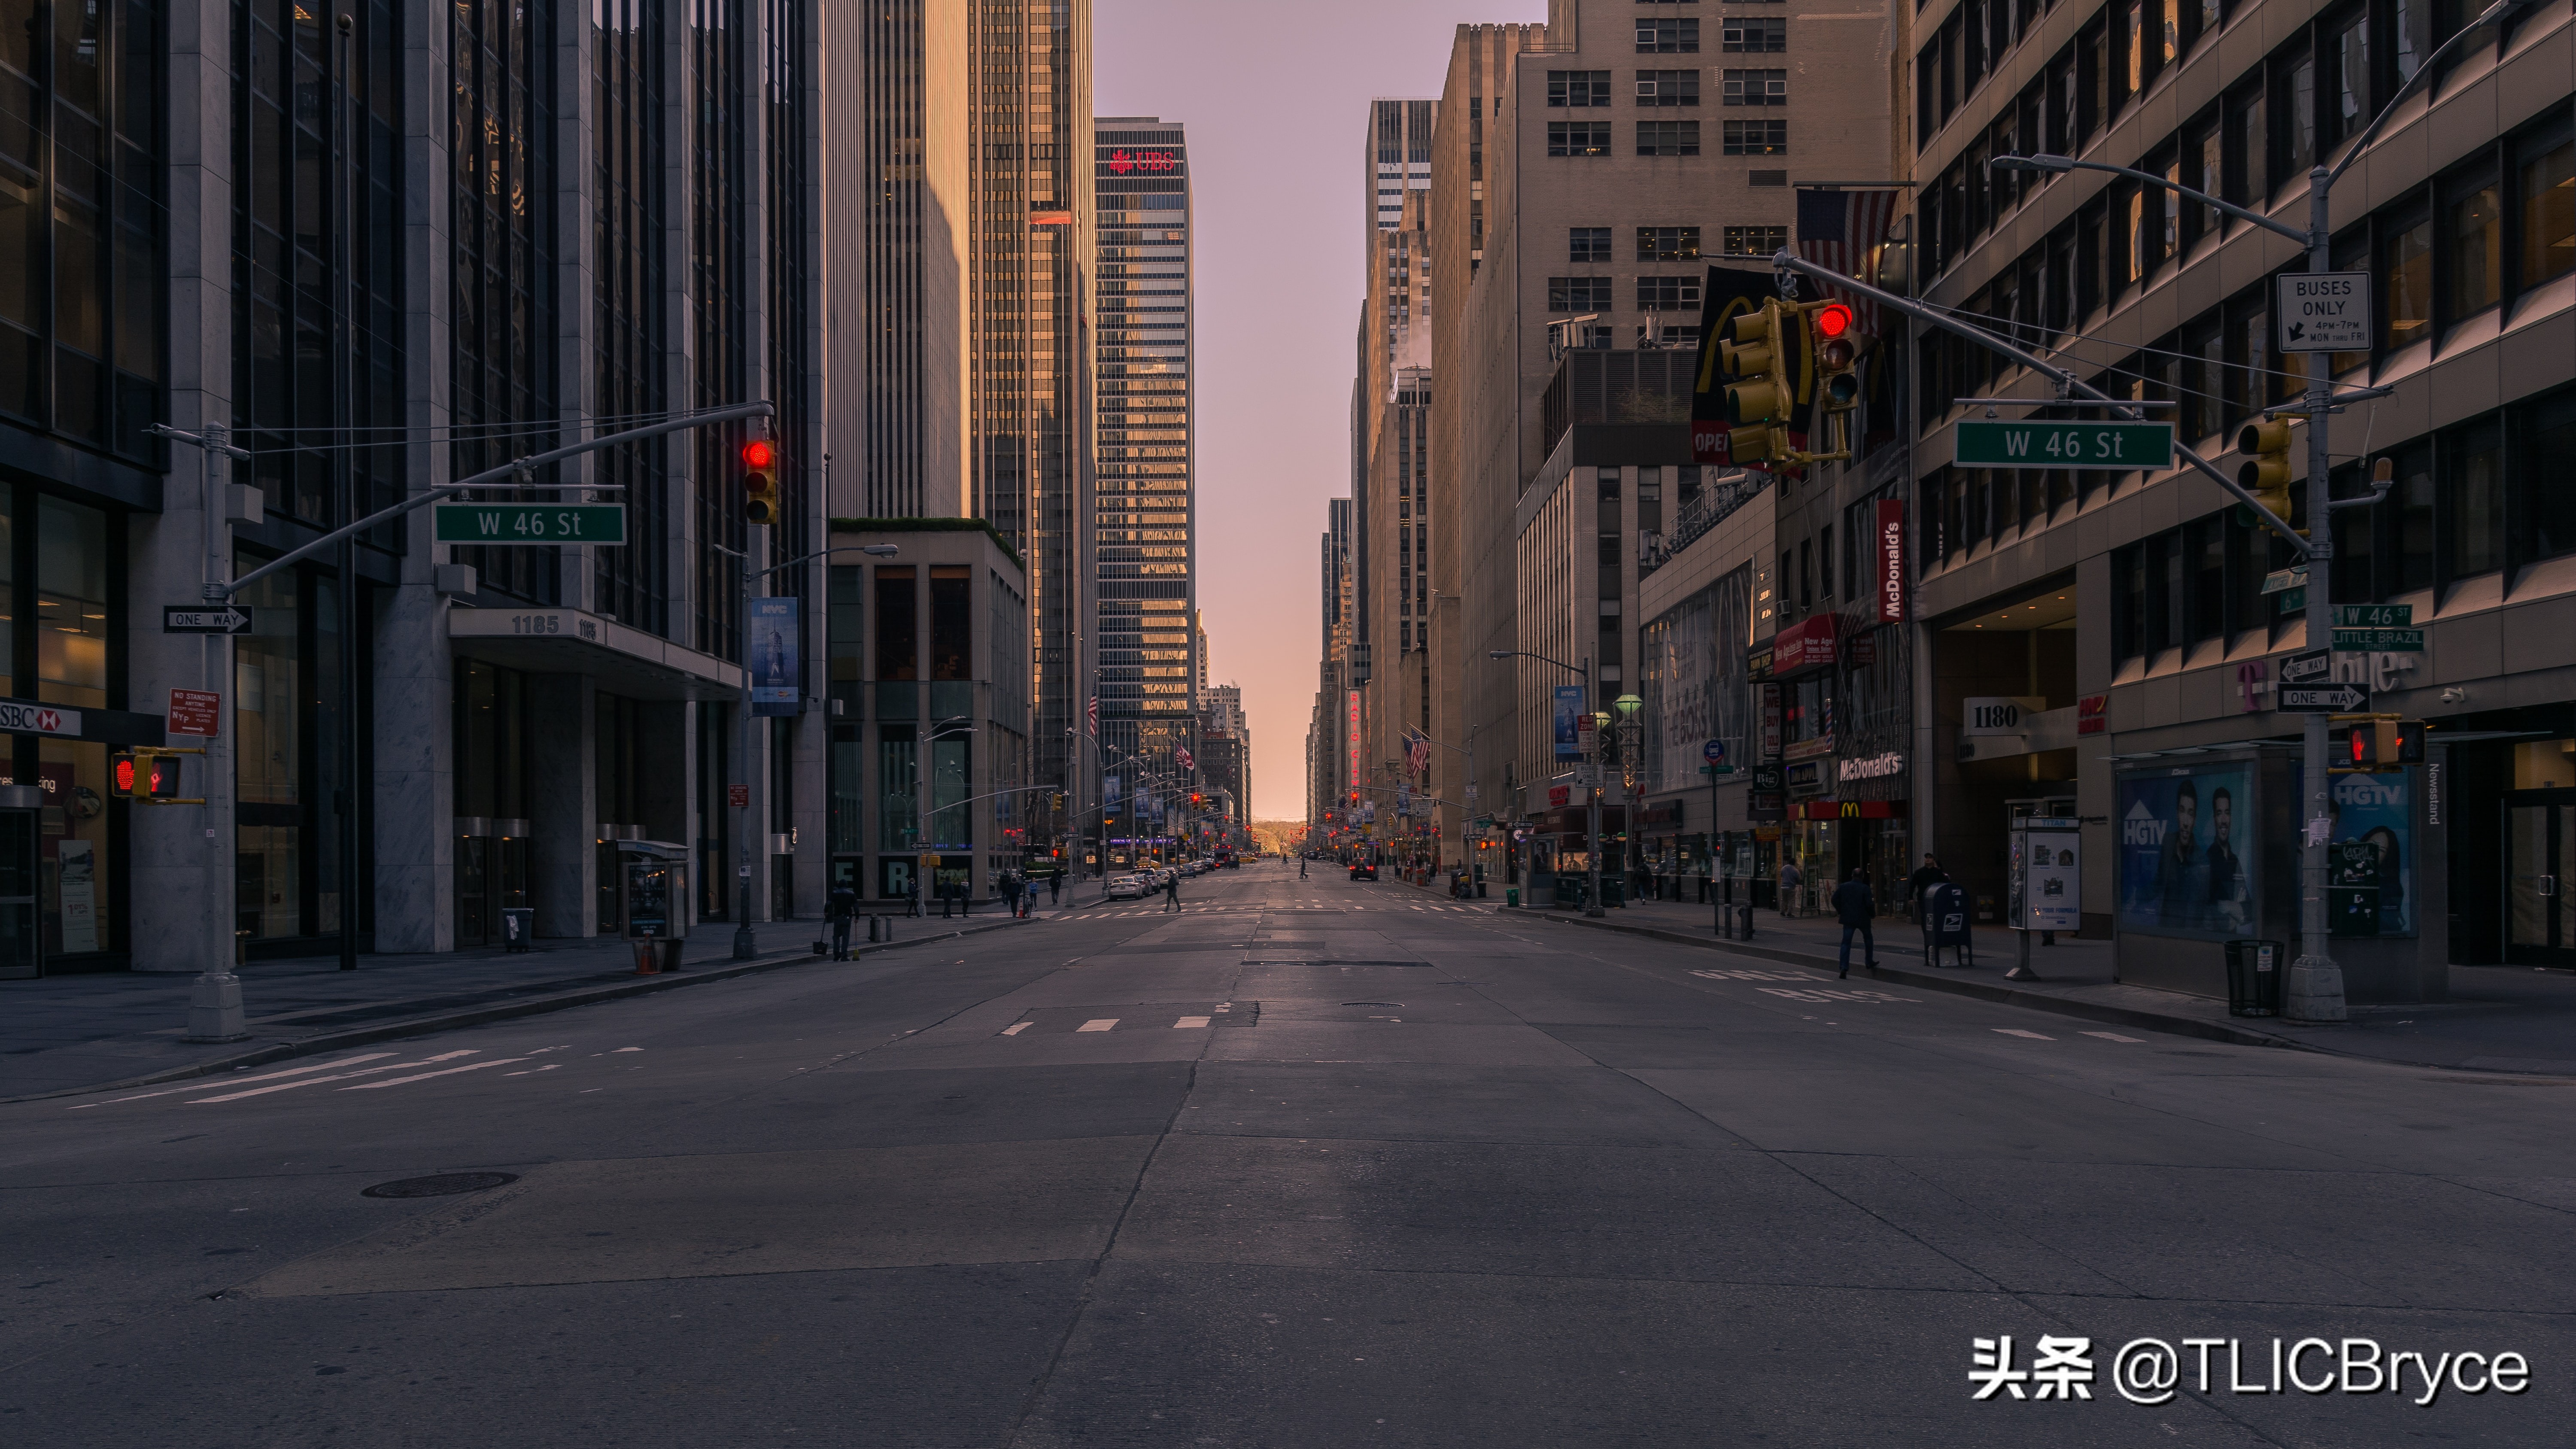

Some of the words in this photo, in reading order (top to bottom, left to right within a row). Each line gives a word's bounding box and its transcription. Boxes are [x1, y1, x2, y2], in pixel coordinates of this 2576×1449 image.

[1135, 152, 1174, 170] UBS
[2297, 281, 2351, 296] BUSES
[2303, 301, 2346, 316] ONLY
[2316, 321, 2359, 329] 4PM-7PM
[2310, 333, 2329, 342] MON
[2351, 332, 2365, 340] FRI
[2005, 431, 2030, 456] W
[2045, 432, 2081, 457] 46
[2096, 432, 2123, 458] St
[478, 513, 500, 535] W
[514, 513, 544, 535] 46
[558, 513, 581, 535] St
[1885, 522, 1900, 618] McDonald's
[762, 605, 787, 614] NYC
[2347, 608, 2360, 624] W
[2369, 608, 2393, 625] 46
[2397, 608, 2409, 617] ST
[176, 614, 201, 625] ONE
[213, 614, 239, 625] WAY
[512, 616, 559, 633] 1185
[580, 619, 596, 640] 1185
[2333, 632, 2372, 643] LITTLE
[2378, 632, 2422, 643] BRAZIL
[1821, 638, 1833, 646] Age
[2287, 664, 2300, 677] ONE
[2308, 656, 2323, 671] WAY
[2237, 661, 2264, 712] T
[186, 693, 216, 702] STANDING
[1765, 696, 1780, 708] WE
[2291, 693, 2317, 704] ONE
[2329, 693, 2357, 704] WAY
[172, 711, 189, 723] NYP
[1351, 694, 1359, 741] RADIO
[1767, 716, 1779, 727] BUY
[1974, 705, 2017, 728] 1180
[1767, 735, 1779, 746] GOLD
[1960, 743, 1975, 759] 1180
[1351, 750, 1359, 786] CITY
[1840, 752, 1901, 781] McDonald's
[1757, 773, 1775, 785] Big
[2334, 785, 2401, 805] HGTV
[2429, 763, 2440, 825] Newsstand
[2123, 820, 2168, 845] HGTV
[1754, 987, 1923, 1004] BUS
